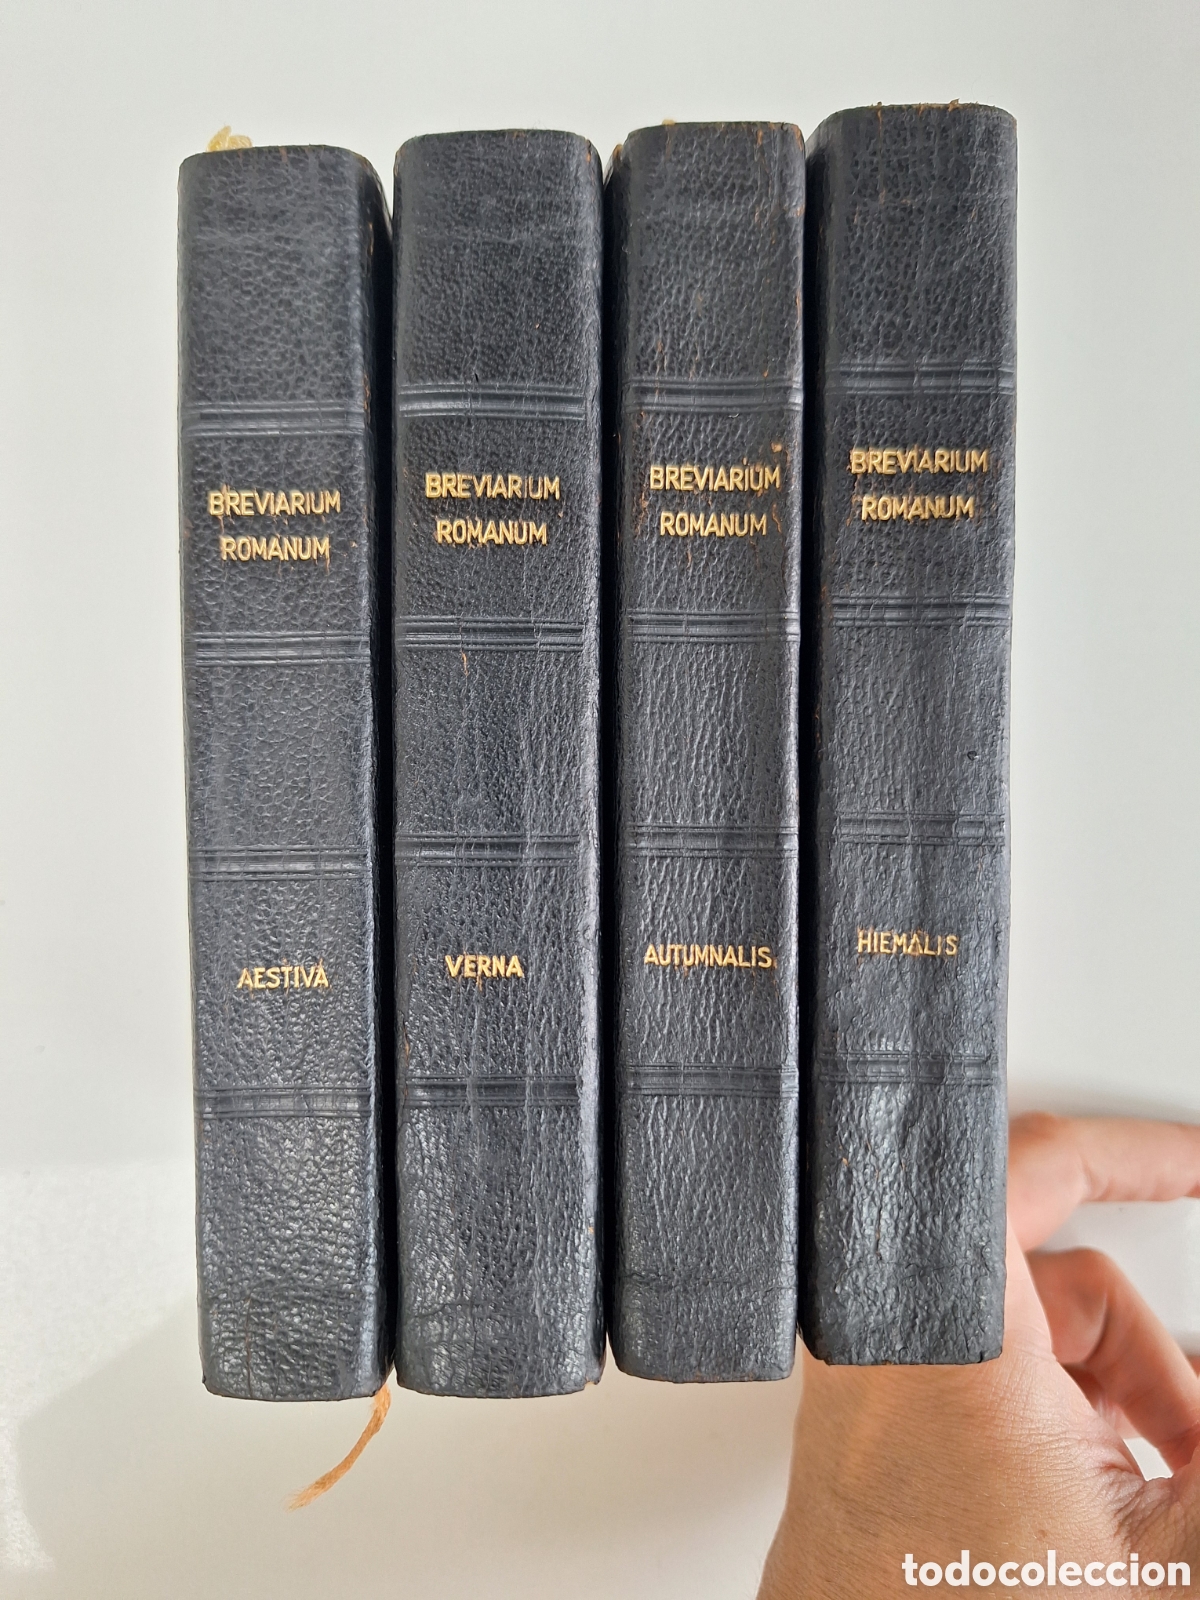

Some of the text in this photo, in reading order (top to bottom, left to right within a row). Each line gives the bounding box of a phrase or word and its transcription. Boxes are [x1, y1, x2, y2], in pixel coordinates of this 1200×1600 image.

[850, 448, 989, 475] BREVIARIUM
[424, 472, 560, 500] BREVIARIUM
[649, 465, 781, 492] BREVIARIUM
[208, 489, 341, 517] BREVIARIUM
[861, 495, 975, 522] ROMANUM
[436, 519, 548, 546] ROMANUM
[659, 510, 767, 538] ROMANUM
[220, 536, 330, 562] ROMANUM
[857, 929, 959, 957] HIEMALIS
[237, 966, 330, 990] AESTIVA
[444, 954, 524, 979] VERNA
